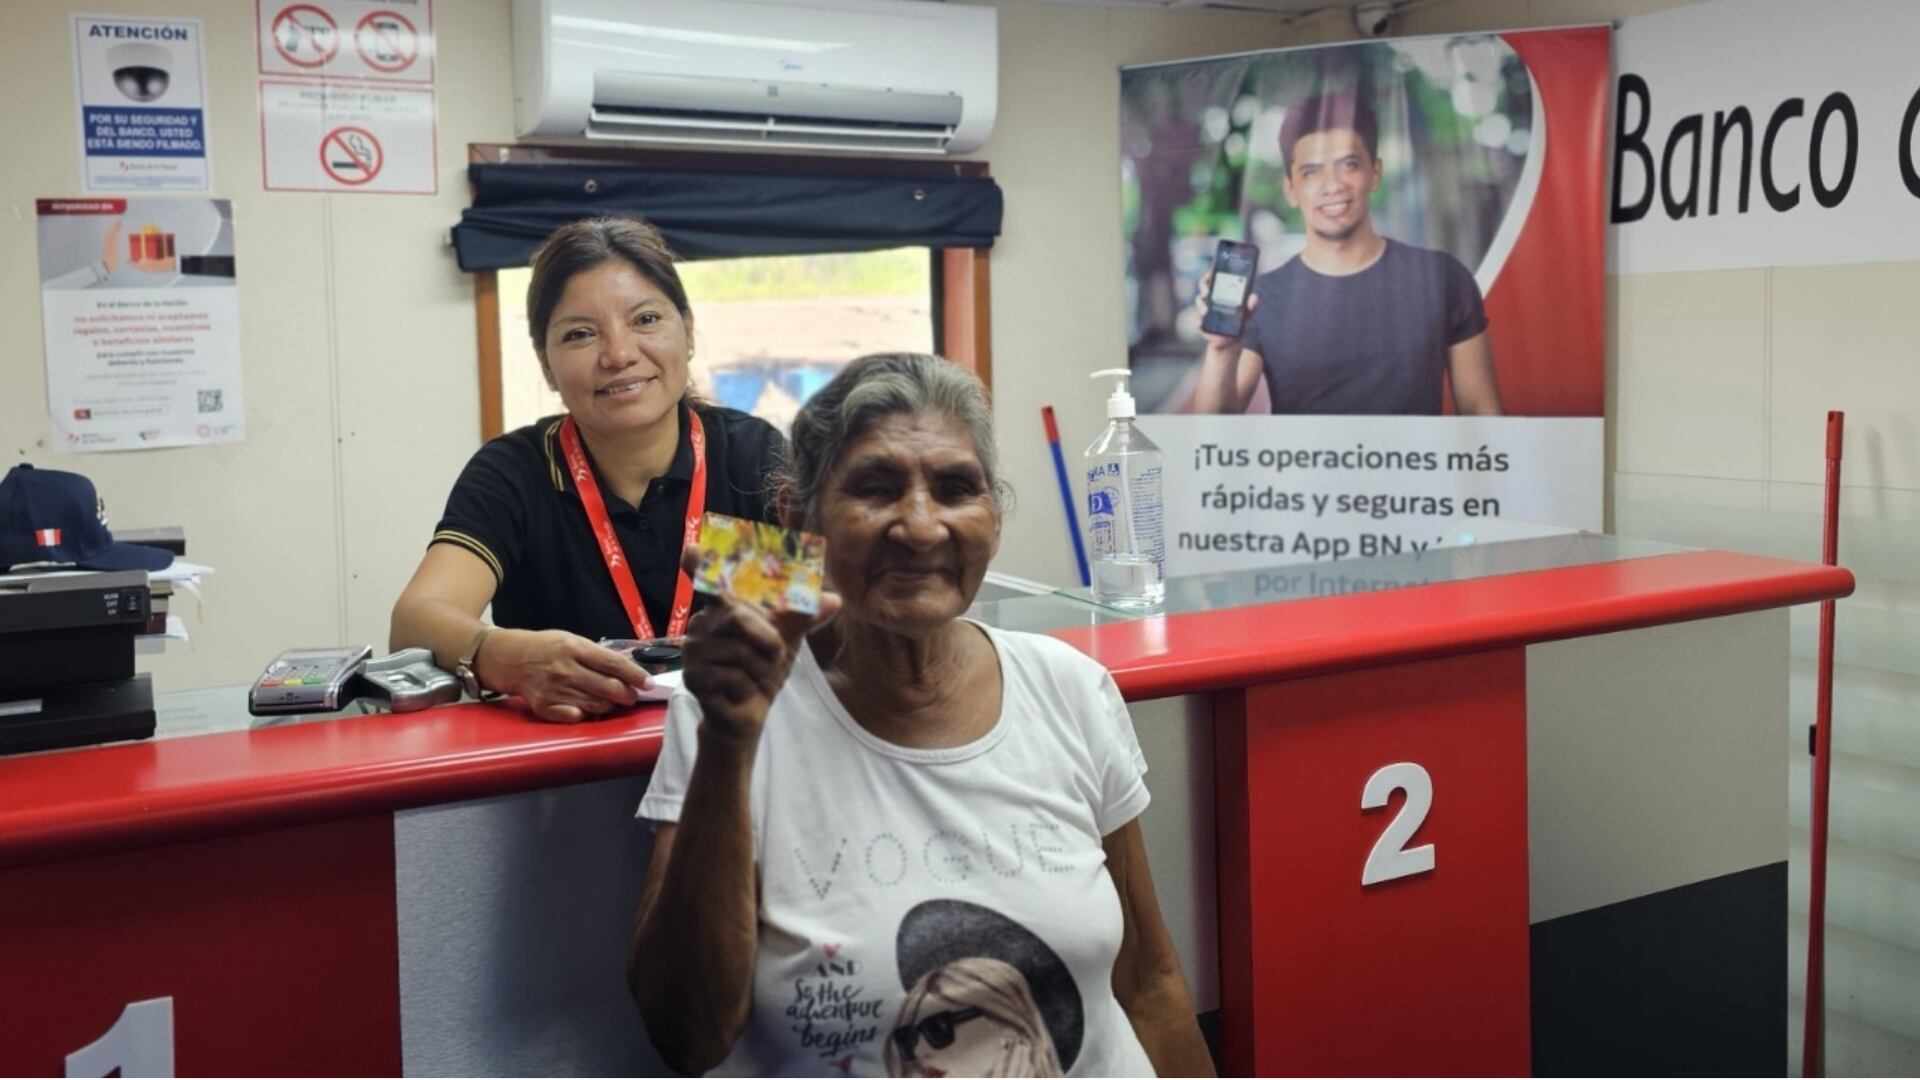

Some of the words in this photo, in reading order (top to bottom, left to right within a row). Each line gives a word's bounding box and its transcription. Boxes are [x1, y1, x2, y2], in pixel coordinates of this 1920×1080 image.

[89, 23, 188, 40] ATENCIÓN
[89, 113, 112, 124] POR
[114, 114, 129, 125] SU
[130, 115, 189, 126] SEGURIDAD
[190, 116, 198, 126] Y
[96, 126, 116, 137] DEL
[159, 127, 193, 138] USTED
[87, 136, 115, 149] ESTÁ
[116, 138, 155, 149] SIENDO
[156, 139, 204, 151] FILMADO.
[1610, 73, 1859, 224] Banco
[1194, 444, 1250, 471] ¡Tus
[1257, 443, 1438, 472] operaciones
[1447, 445, 1510, 472] más
[1201, 484, 1305, 514] rápidas
[1313, 493, 1330, 517] y
[1337, 493, 1454, 519] seguras
[1463, 496, 1500, 517] en
[1179, 530, 1285, 555] nuestra
[1291, 532, 1351, 561] App
[1359, 534, 1401, 558] BN
[1361, 762, 1436, 887] 2
[794, 823, 1076, 900] VOGUE
[64, 996, 174, 1078] 1
